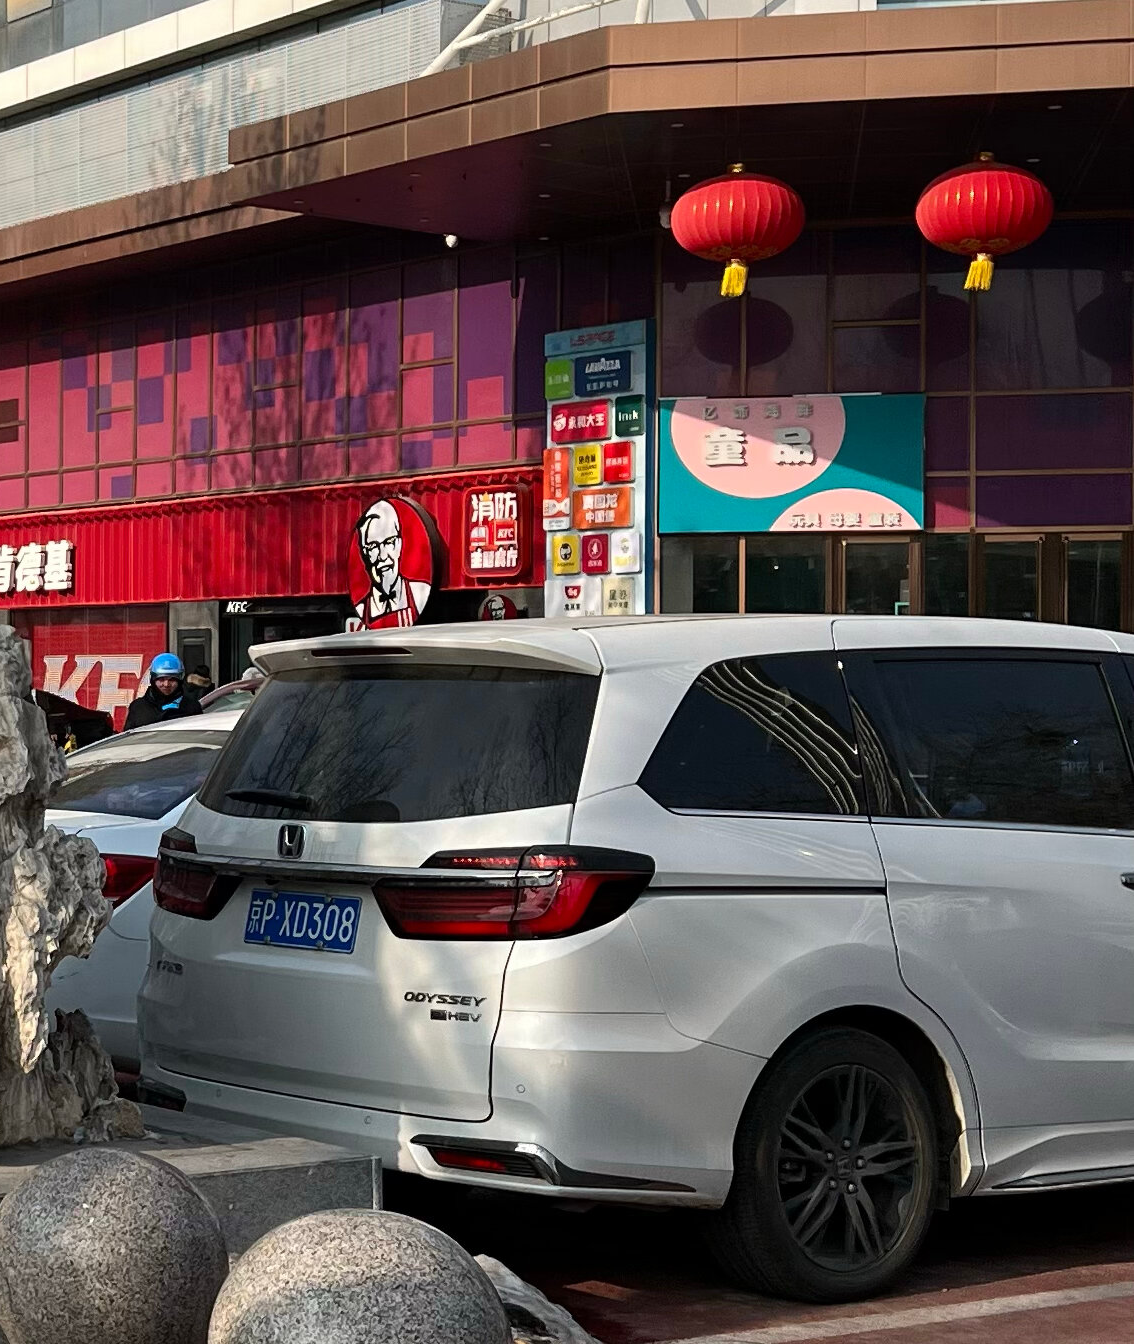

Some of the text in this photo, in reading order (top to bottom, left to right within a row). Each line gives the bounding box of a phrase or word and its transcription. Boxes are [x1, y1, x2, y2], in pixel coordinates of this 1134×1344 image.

[470, 492, 518, 527] 消防
[226, 600, 248, 613] KFC
[404, 991, 487, 1007] ODYSSEY
